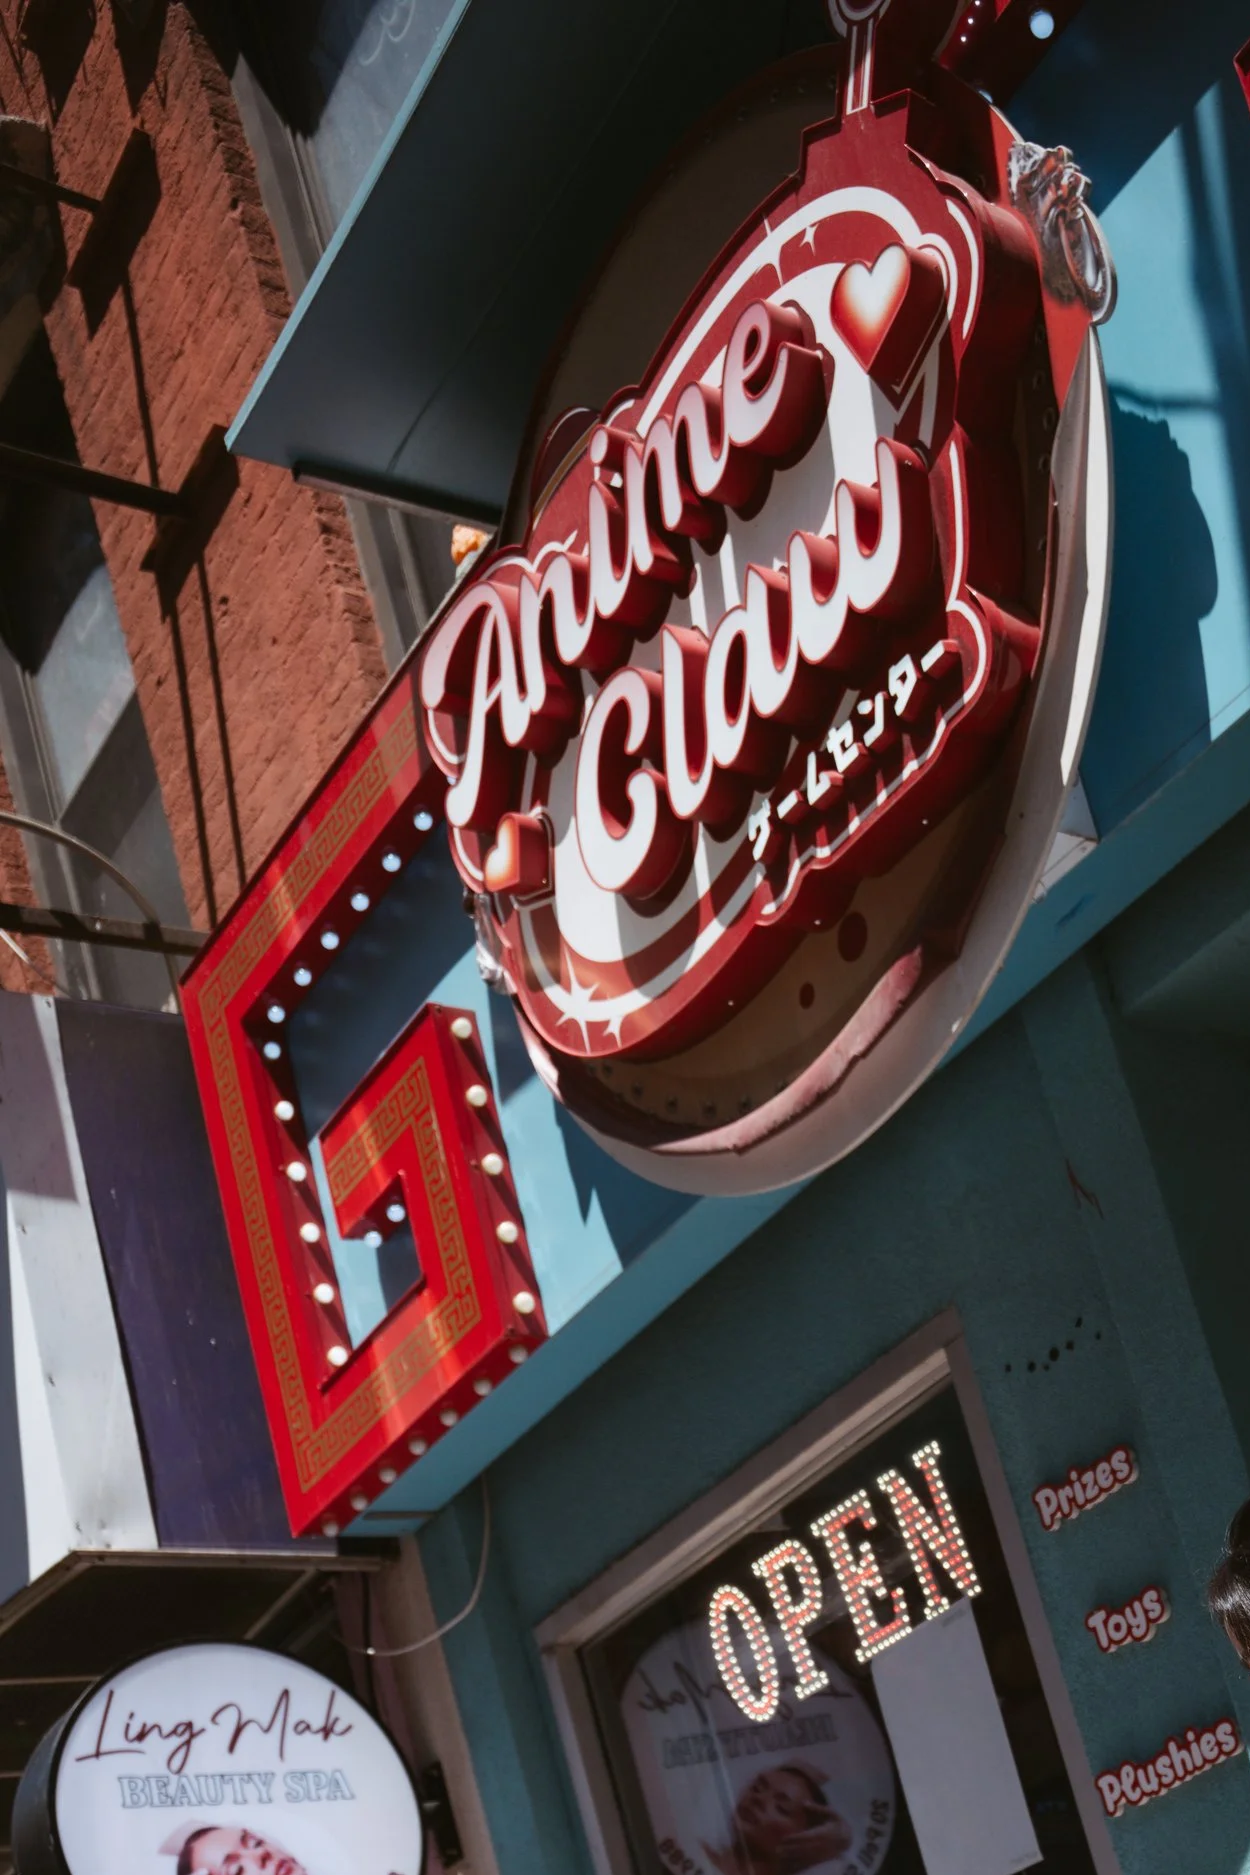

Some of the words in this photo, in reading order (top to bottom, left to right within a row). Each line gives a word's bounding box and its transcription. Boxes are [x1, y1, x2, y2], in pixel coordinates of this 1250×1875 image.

[421, 298, 800, 828] Anime
[575, 437, 905, 893] Claw
[747, 640, 948, 861] ゲームセンター
[1034, 1445, 1135, 1530] Prizes
[709, 1440, 982, 1722] OPEN
[1087, 1586, 1167, 1652] Toys
[75, 1689, 206, 1774] Ling
[211, 1688, 354, 1762] Mak
[1097, 1718, 1243, 1816] Plushies
[118, 1771, 276, 1808] BEAUTY
[284, 1768, 356, 1803] SPA
